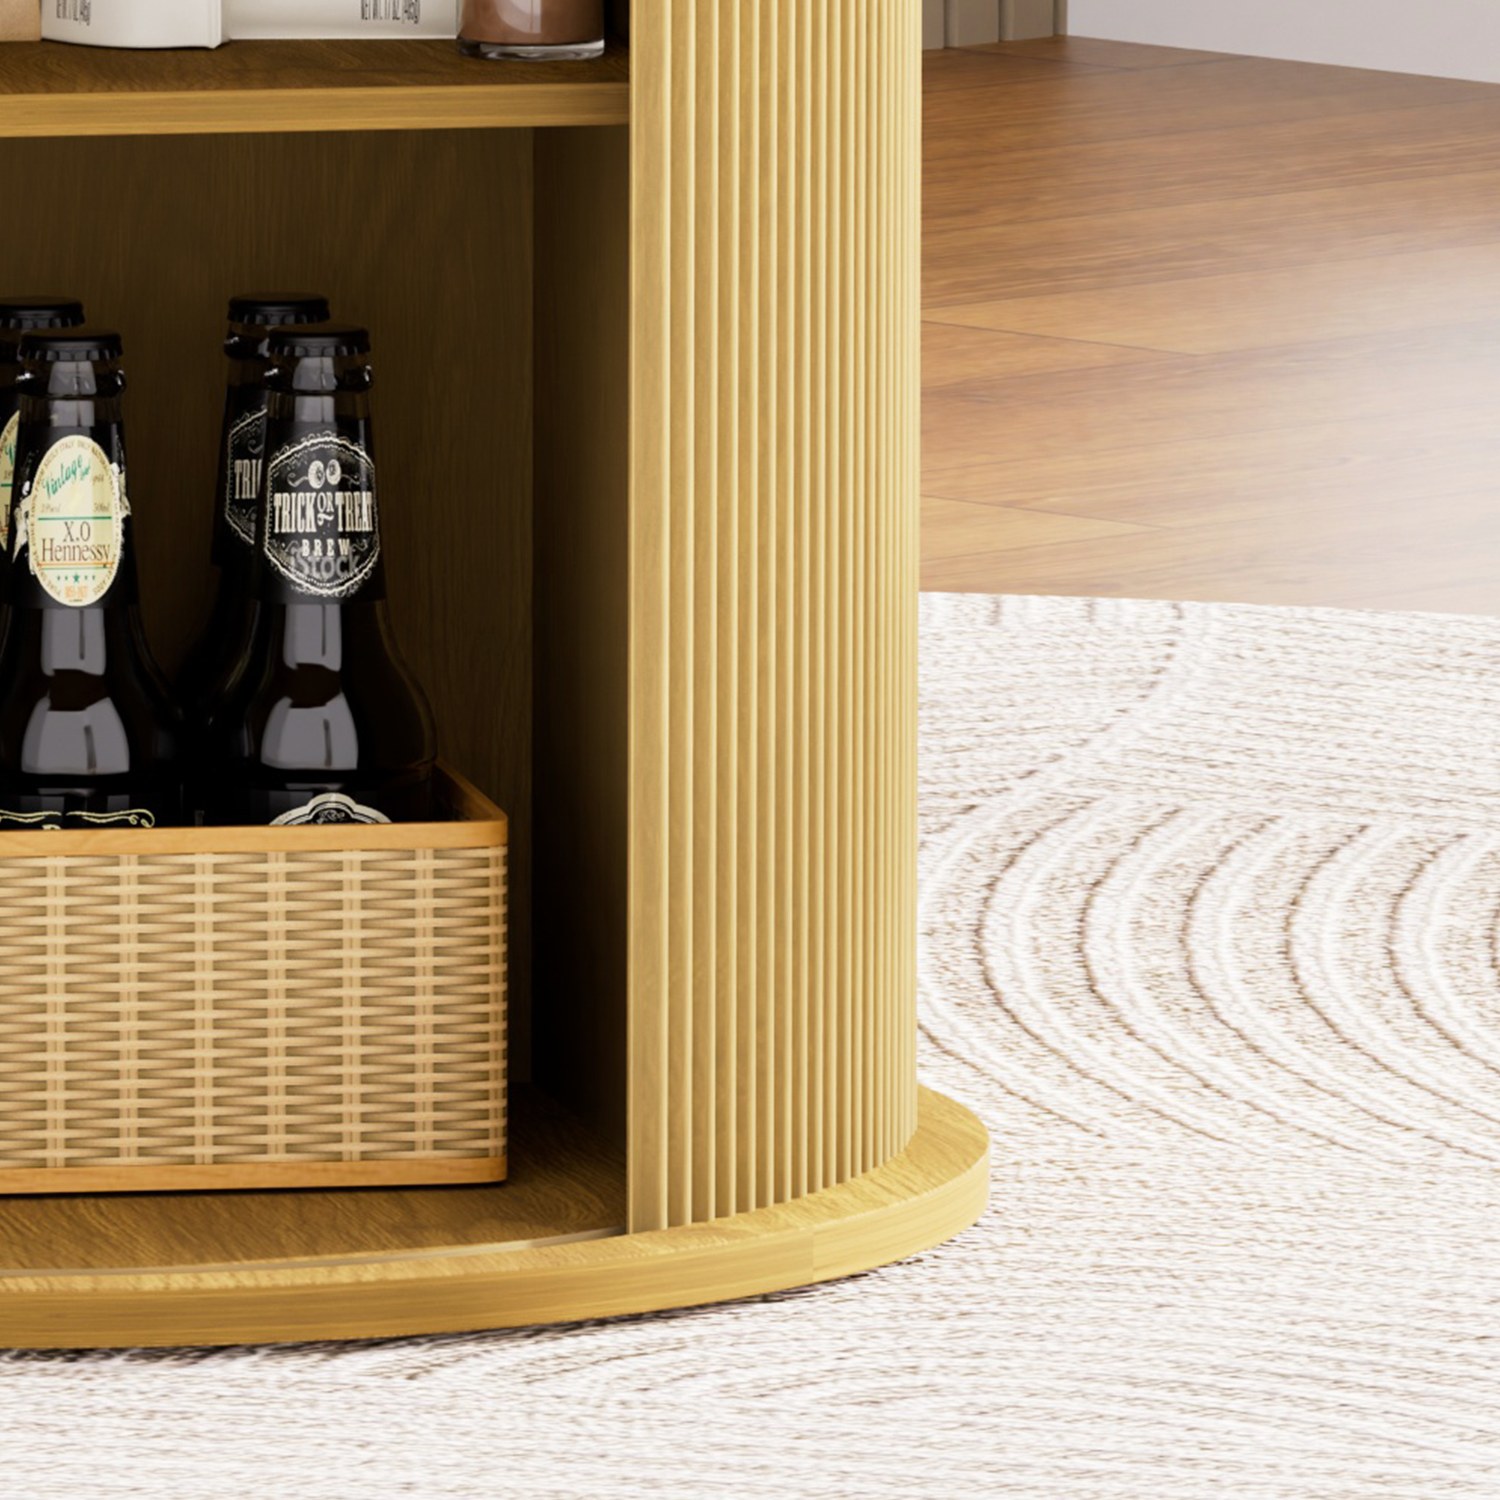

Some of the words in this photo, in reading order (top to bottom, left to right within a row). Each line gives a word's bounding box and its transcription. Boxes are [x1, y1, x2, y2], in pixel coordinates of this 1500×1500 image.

[234, 458, 263, 499] TRI
[273, 492, 317, 533] TRICK
[317, 491, 335, 514] OR
[335, 491, 373, 532] TREAT
[41, 537, 111, 565] Hennessy
[301, 538, 350, 557] BREW
